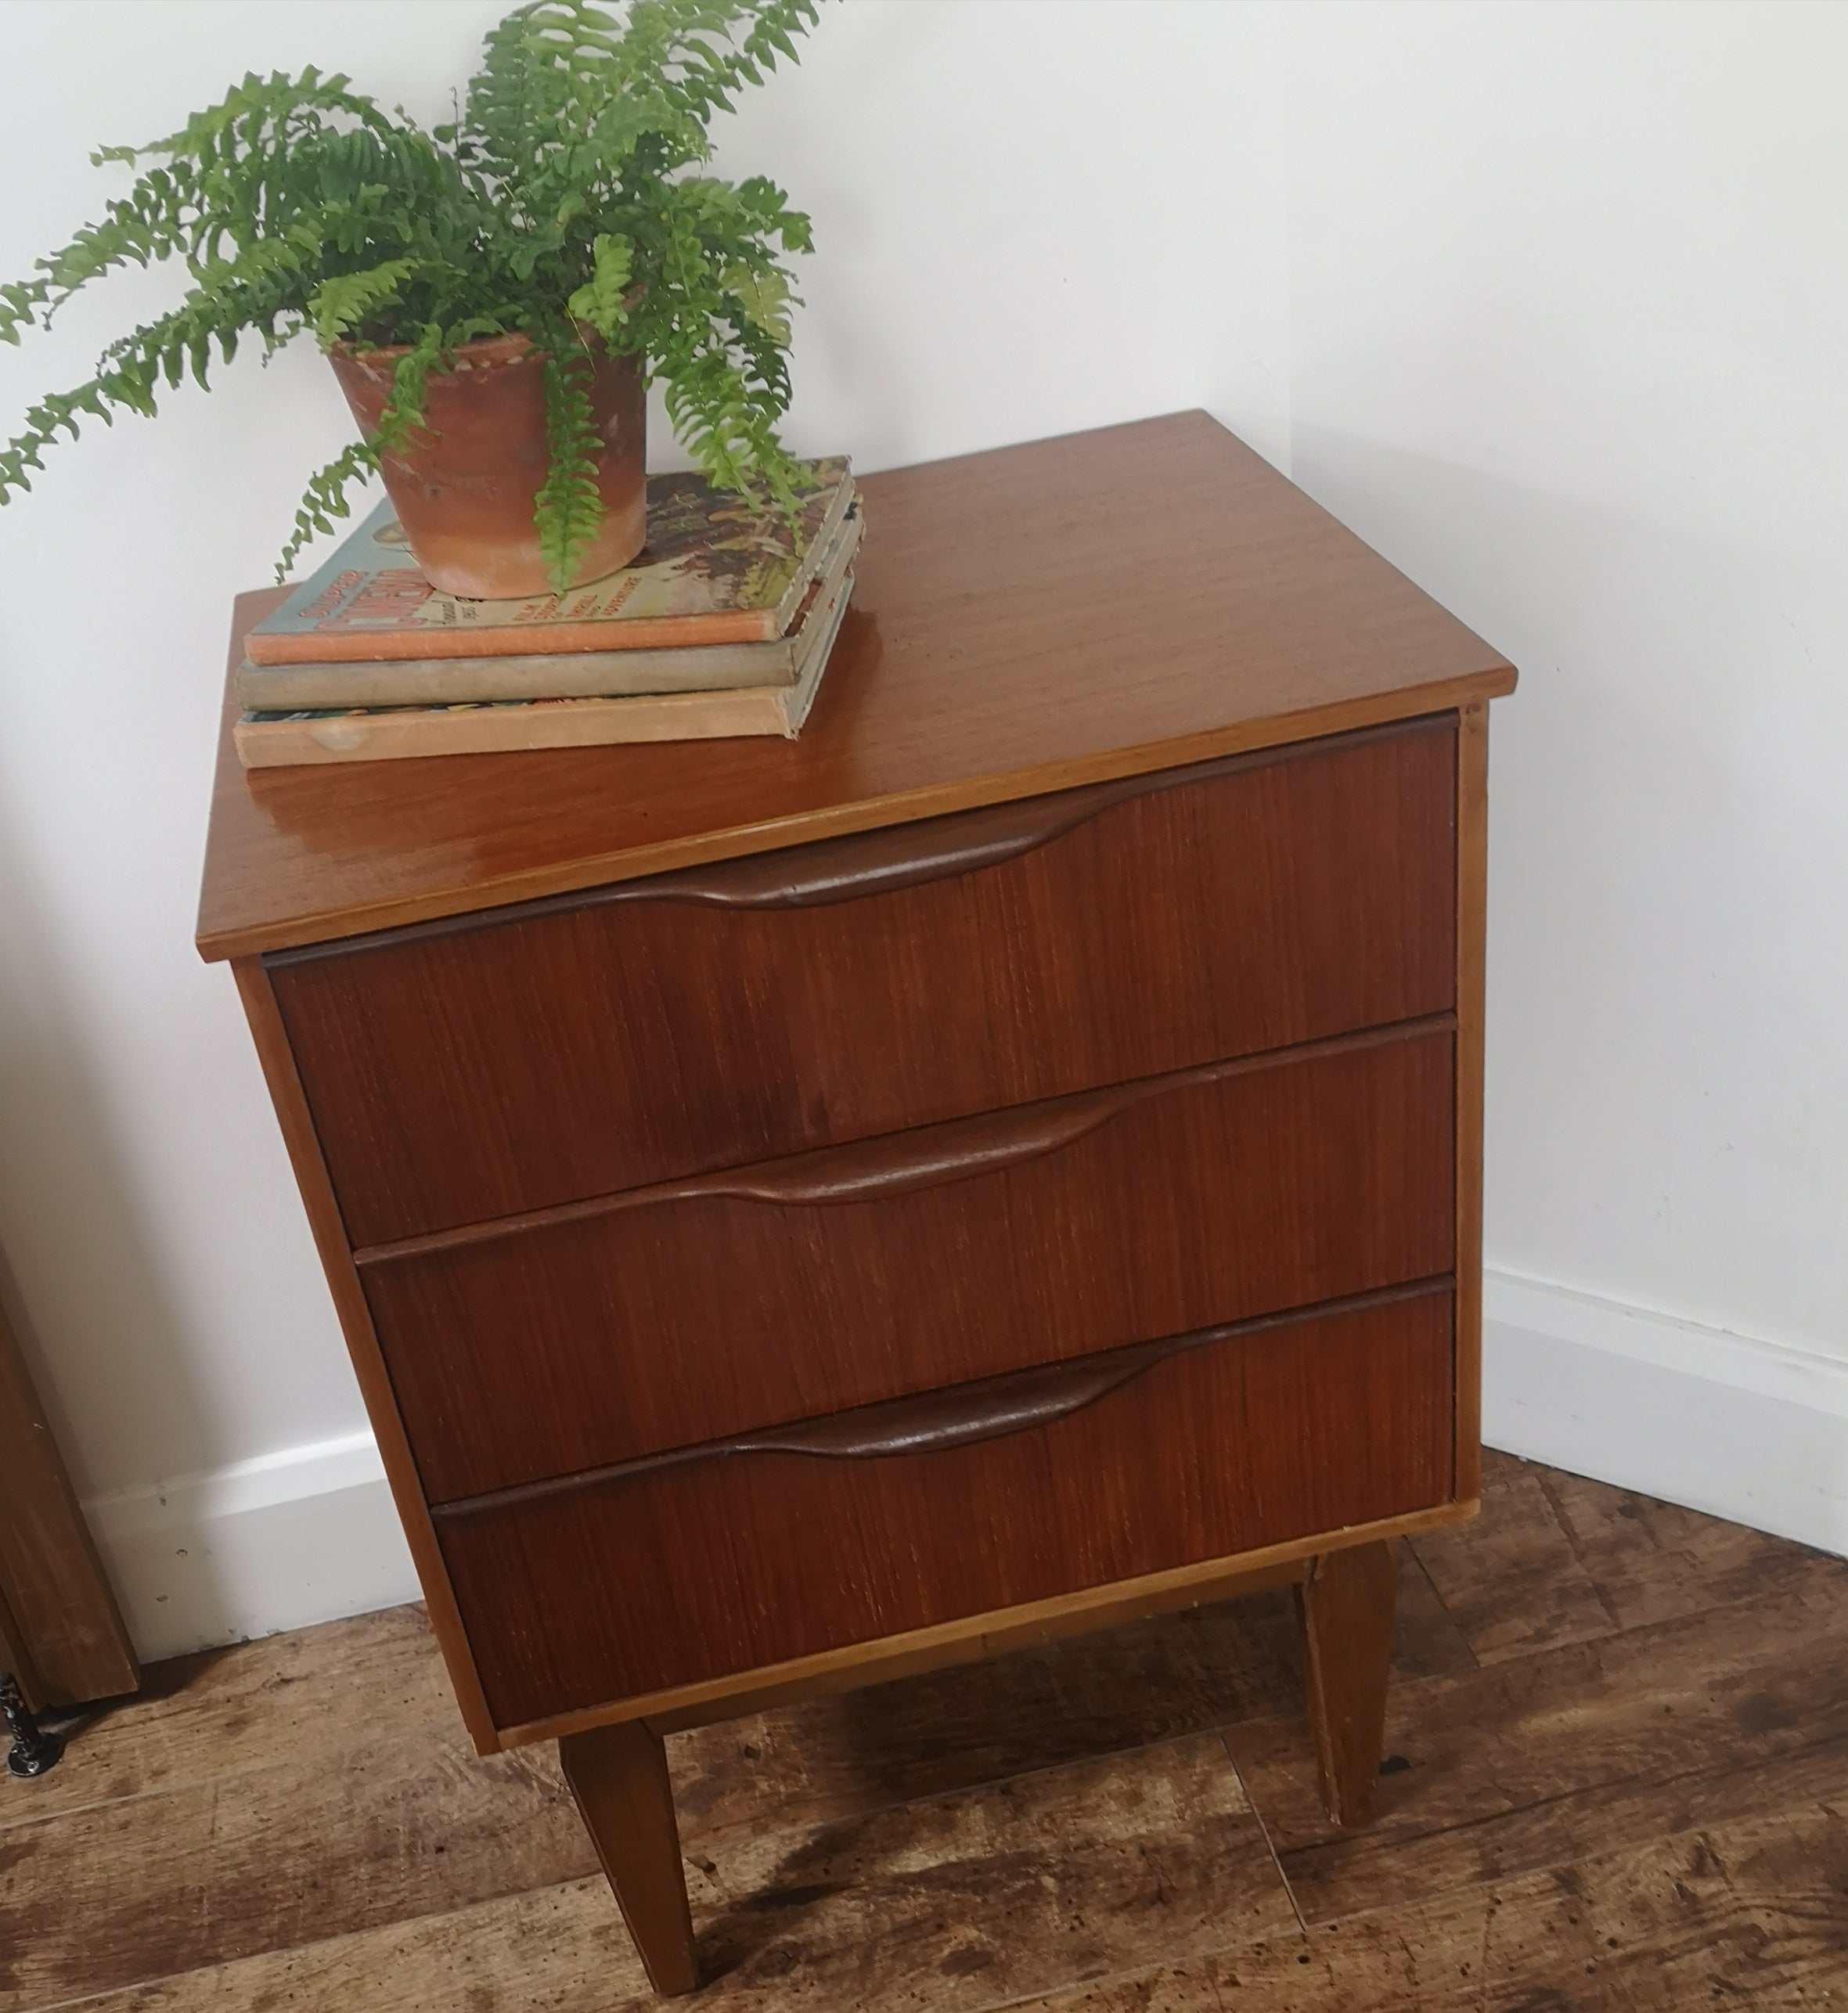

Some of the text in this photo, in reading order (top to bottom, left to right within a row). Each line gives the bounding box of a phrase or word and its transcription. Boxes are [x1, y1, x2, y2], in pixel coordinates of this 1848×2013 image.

[298, 570, 369, 619] SUPER
[565, 594, 598, 618] THRILL
[600, 576, 643, 616] ADVENTURE
[513, 604, 541, 621] FILM
